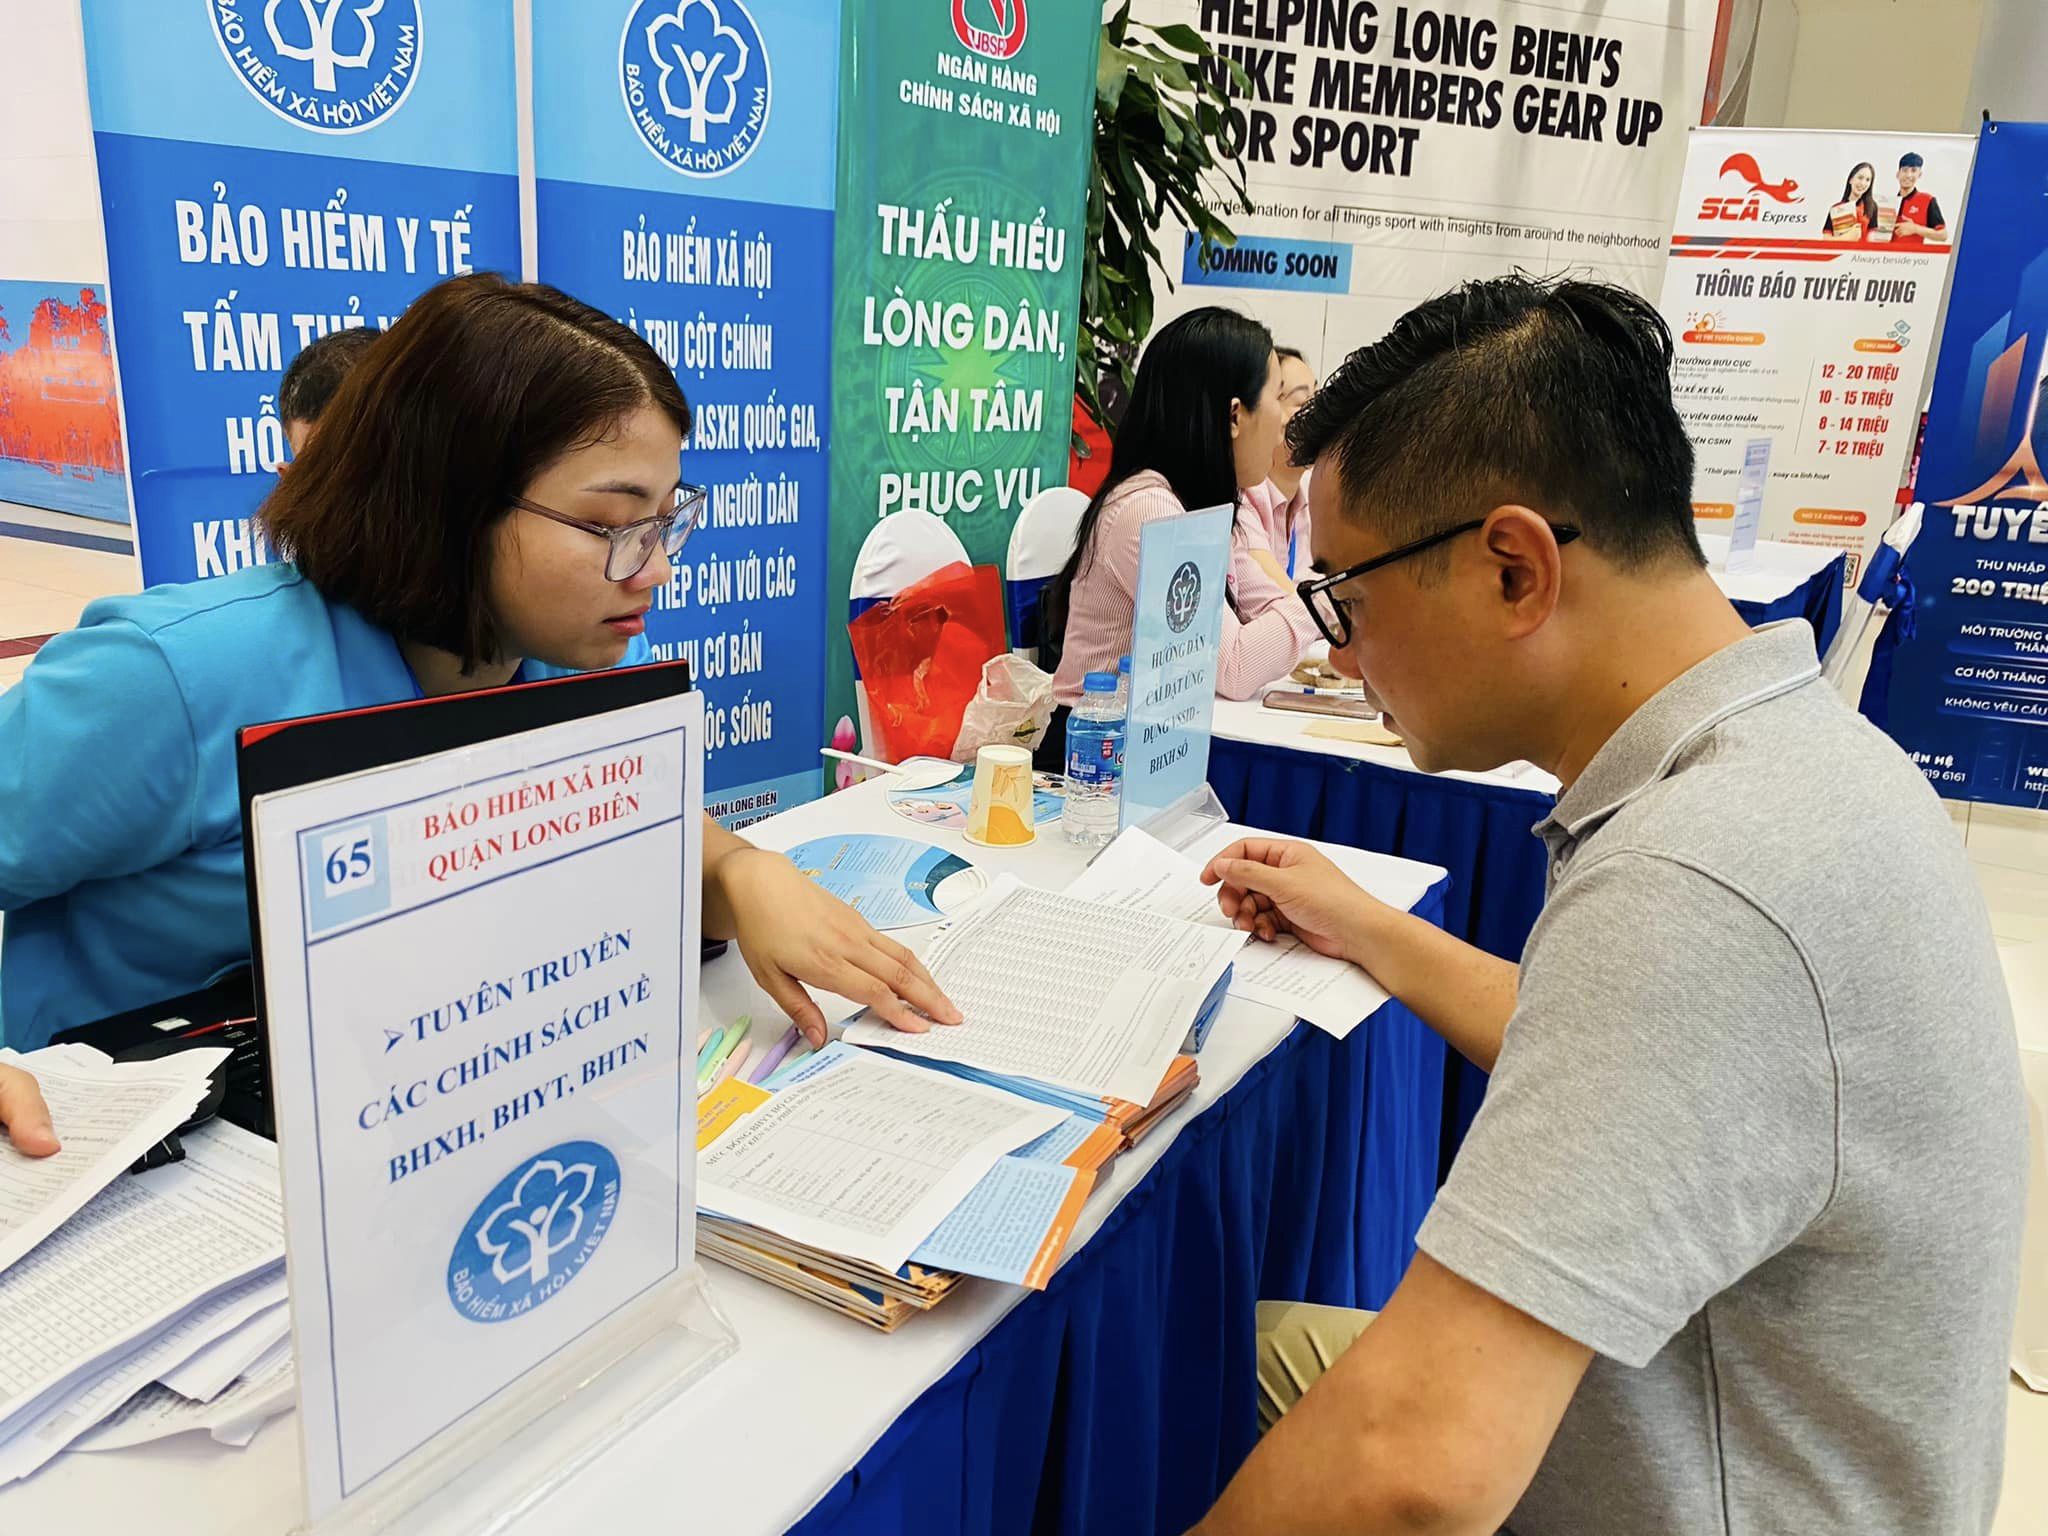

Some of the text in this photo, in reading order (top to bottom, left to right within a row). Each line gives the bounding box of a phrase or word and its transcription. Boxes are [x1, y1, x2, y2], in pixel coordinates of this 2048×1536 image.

[1200, 0, 1379, 54] HELPING
[1392, 7, 1499, 71] LONG
[236, 46, 287, 104] HIỂM
[287, 91, 321, 122] XÃ
[323, 100, 363, 126] HỘI
[363, 74, 402, 114] VIỆT
[391, 25, 416, 79] NAM
[937, 52, 1038, 97] NGÂN HÀNG
[1197, 41, 1664, 148] NIKE MEMBERS GEAR UP
[670, 147, 693, 169] XÃ
[695, 149, 724, 171] HỘI
[722, 127, 753, 162] VIỆT
[746, 87, 767, 132] NAM
[899, 79, 1061, 138] CHÍNH SÁCH XÃ HỘI
[1200, 103, 1420, 177] OR SPORT
[175, 182, 474, 276] BẢO HIỂM Y TẾ
[877, 197, 1066, 273] THẤU HIỂU
[1225, 199, 1661, 249] desination for all things sport with insights from around the neighborhood
[1761, 210, 1808, 225] Express
[622, 214, 772, 299] BẢO HIỂM XÃ HỘI
[1209, 247, 1338, 278] OMING SOON
[1851, 254, 1930, 267] Always beside you
[1695, 268, 1917, 308] THÔNG BÁO TUYỂN DỤNG
[183, 290, 282, 371] TẤM
[684, 312, 717, 380] CỘT
[721, 313, 772, 370] CHÍNH
[863, 285, 1065, 362] LÒNG DÂN,
[1819, 389, 1894, 410] 10 15 TRIỆU
[1822, 363, 1900, 384] 12 20 TRIỆU
[226, 394, 284, 475] HỖ
[695, 388, 821, 454] ASXH QUỐC GIA,
[885, 378, 1044, 442] TẬN TÂM
[1819, 416, 1889, 436] 8 14 TRIỆU
[1835, 441, 1848, 455] 12
[1852, 440, 1884, 460] TRIỆU
[712, 472, 799, 529] NGƯỜI DÂN
[878, 470, 983, 521] PHỤC
[697, 547, 796, 614] CẬN VỚI CÁC
[1951, 577, 1996, 597] 200
[1976, 559, 2046, 575] THU NHẬP
[704, 631, 726, 679] CƠ
[730, 618, 762, 675] BẢN
[1961, 624, 1987, 636] MÔI
[1989, 626, 2042, 641] TRƯỜNG
[1954, 667, 2046, 685] CƠ HỘI THĂNG
[731, 690, 773, 747] SỐNG
[1944, 697, 1991, 711] KHÔNG
[1993, 701, 2019, 714] YÊU
[1150, 748, 1176, 775] BHXH
[1934, 754, 1954, 768] HỆ
[1942, 771, 1966, 782] 6161
[423, 754, 645, 841] BẢO HIỂM XÃ HỘI
[730, 790, 777, 814] LONG BIÊN
[325, 838, 373, 885] 65
[428, 792, 641, 881] QUẬN LONG BIÊN
[410, 929, 632, 1042] TUYÊN TRUYỀN
[358, 973, 652, 1131] CÁC CHÍNH SÁCH VỀ
[389, 1033, 649, 1185] BHXH, BHYT, BHTN
